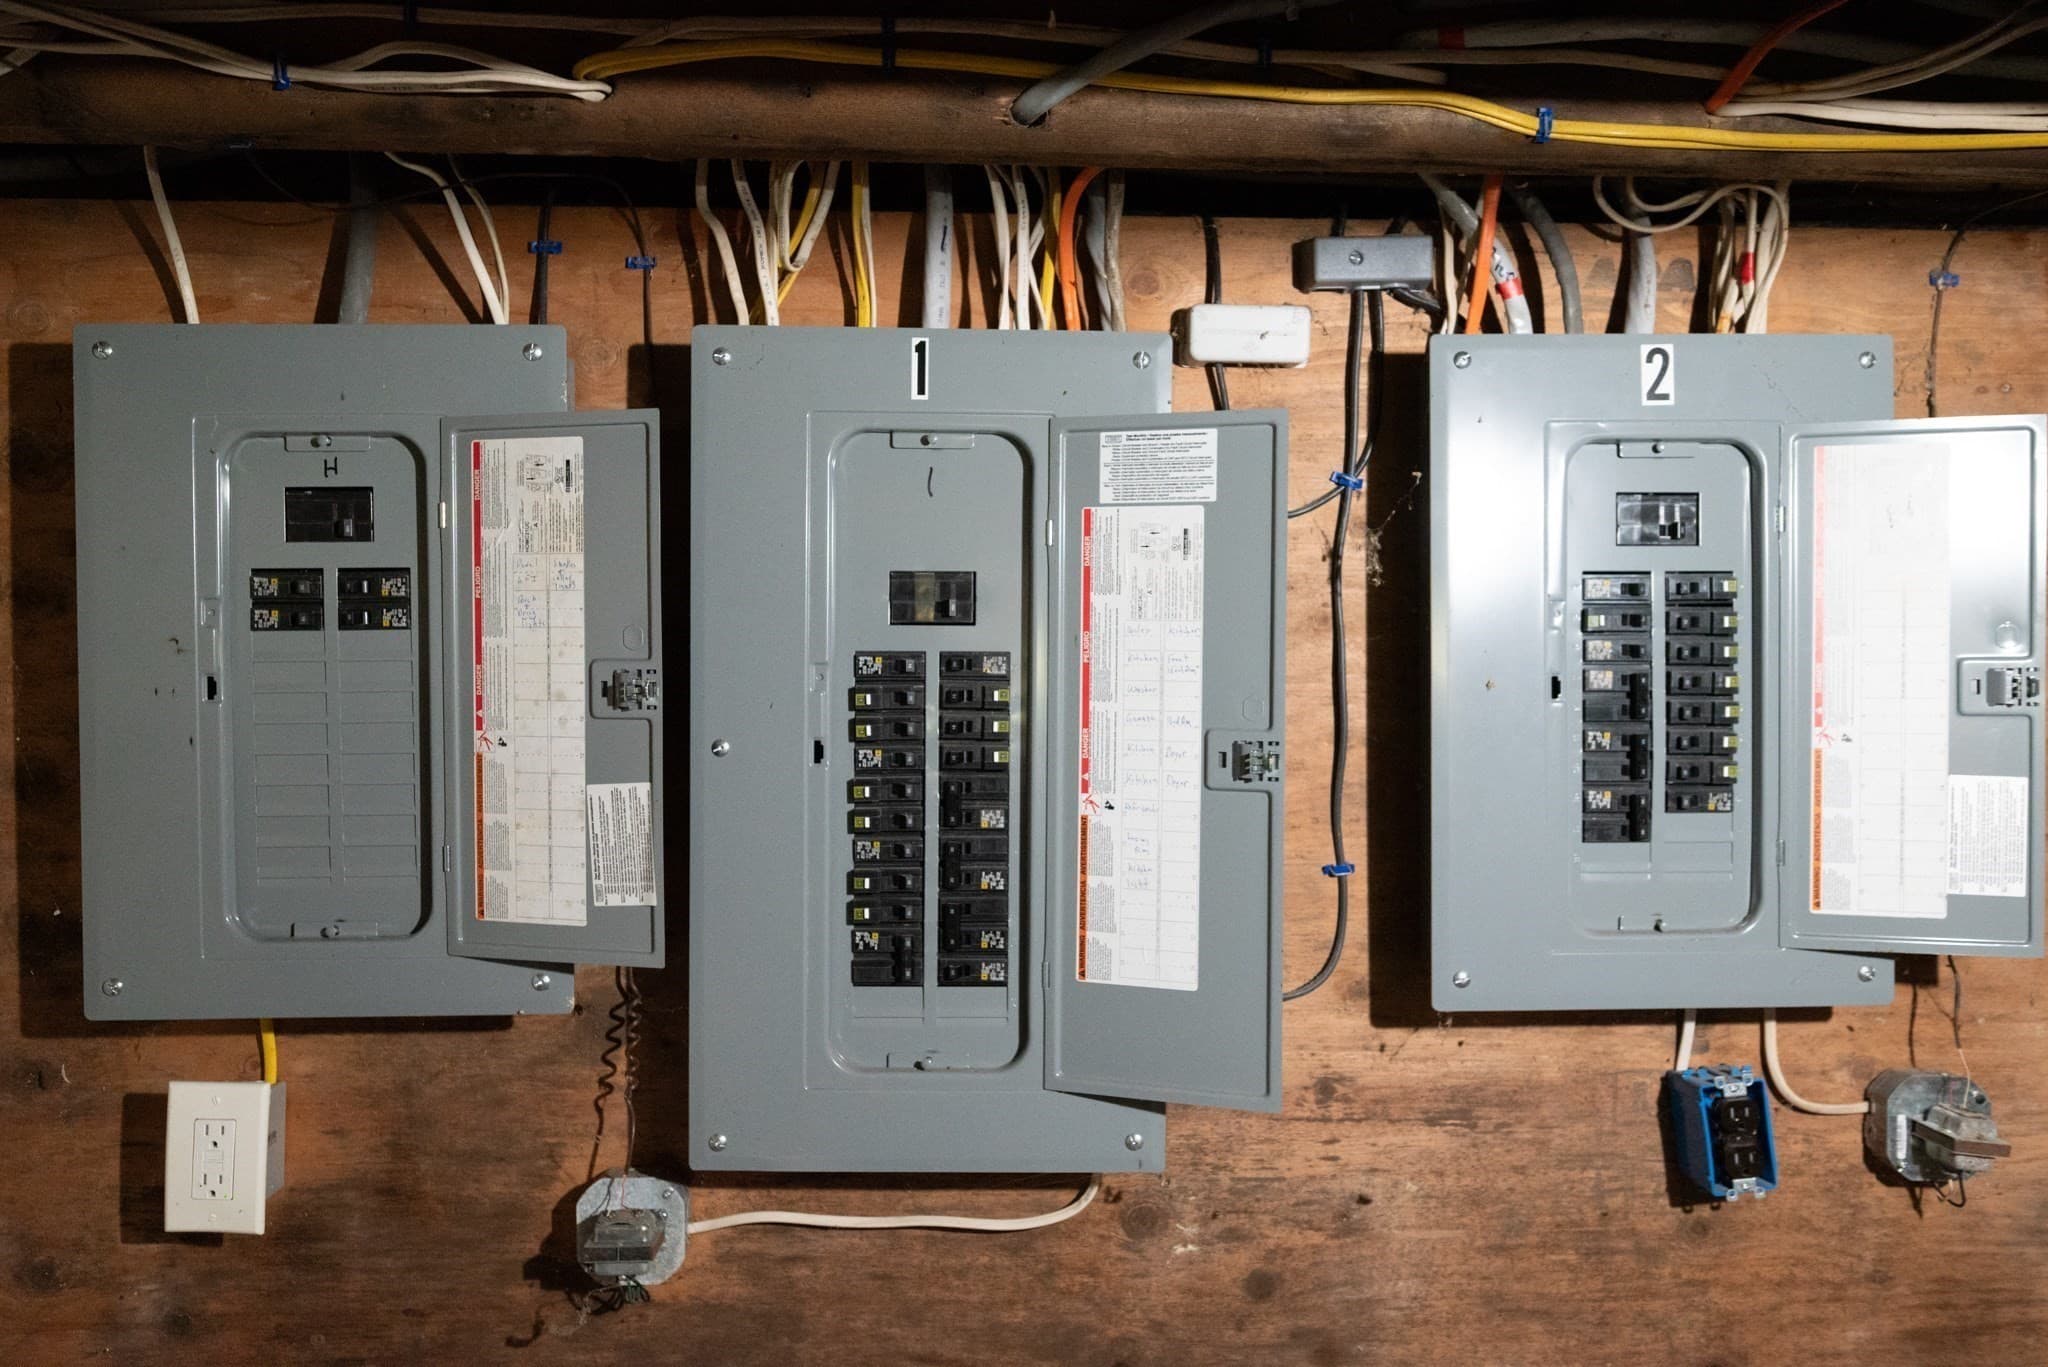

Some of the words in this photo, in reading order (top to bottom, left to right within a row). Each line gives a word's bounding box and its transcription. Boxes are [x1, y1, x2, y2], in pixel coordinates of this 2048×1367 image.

[915, 341, 926, 395] 1
[1646, 347, 1670, 400] 2
[324, 457, 338, 478] H
[1814, 749, 1822, 808] AVERTISSEMENT
